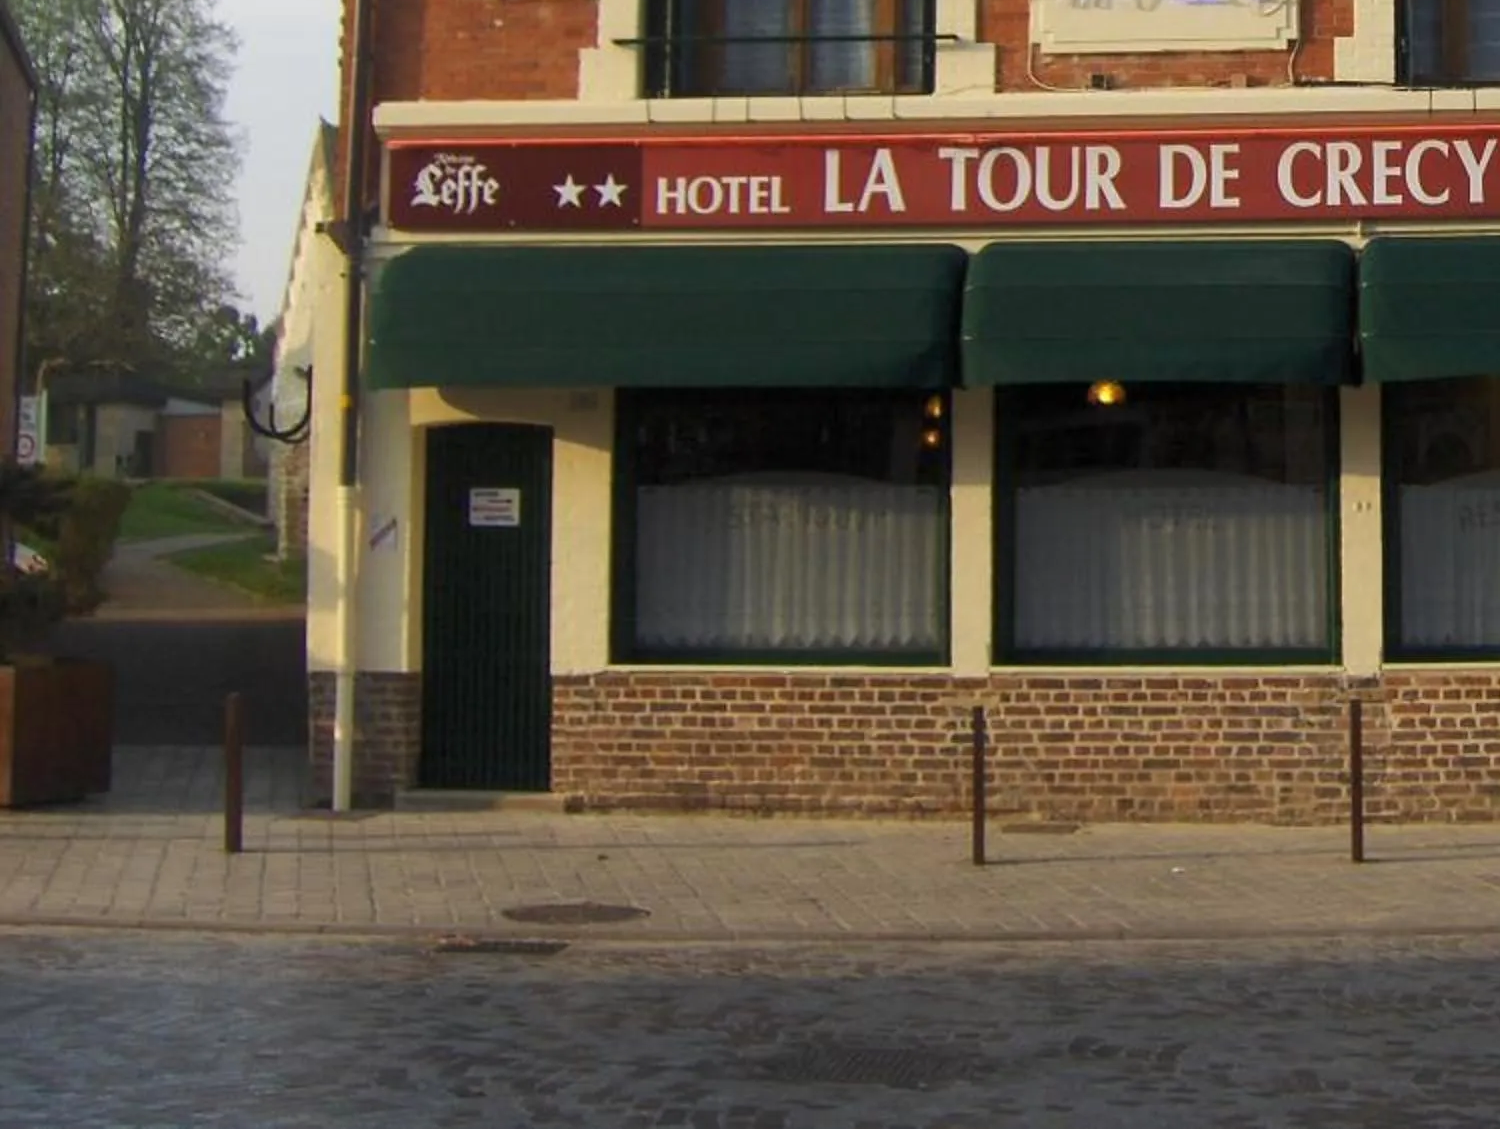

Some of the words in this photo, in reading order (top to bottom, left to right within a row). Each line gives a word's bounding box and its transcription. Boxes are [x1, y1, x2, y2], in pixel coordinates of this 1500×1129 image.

[411, 163, 500, 214] Leffe
[656, 176, 791, 215] HOTEL
[824, 148, 906, 213] LA
[938, 145, 1127, 213] TOUR
[1159, 143, 1241, 208] DE
[1277, 138, 1497, 208] CRECY
